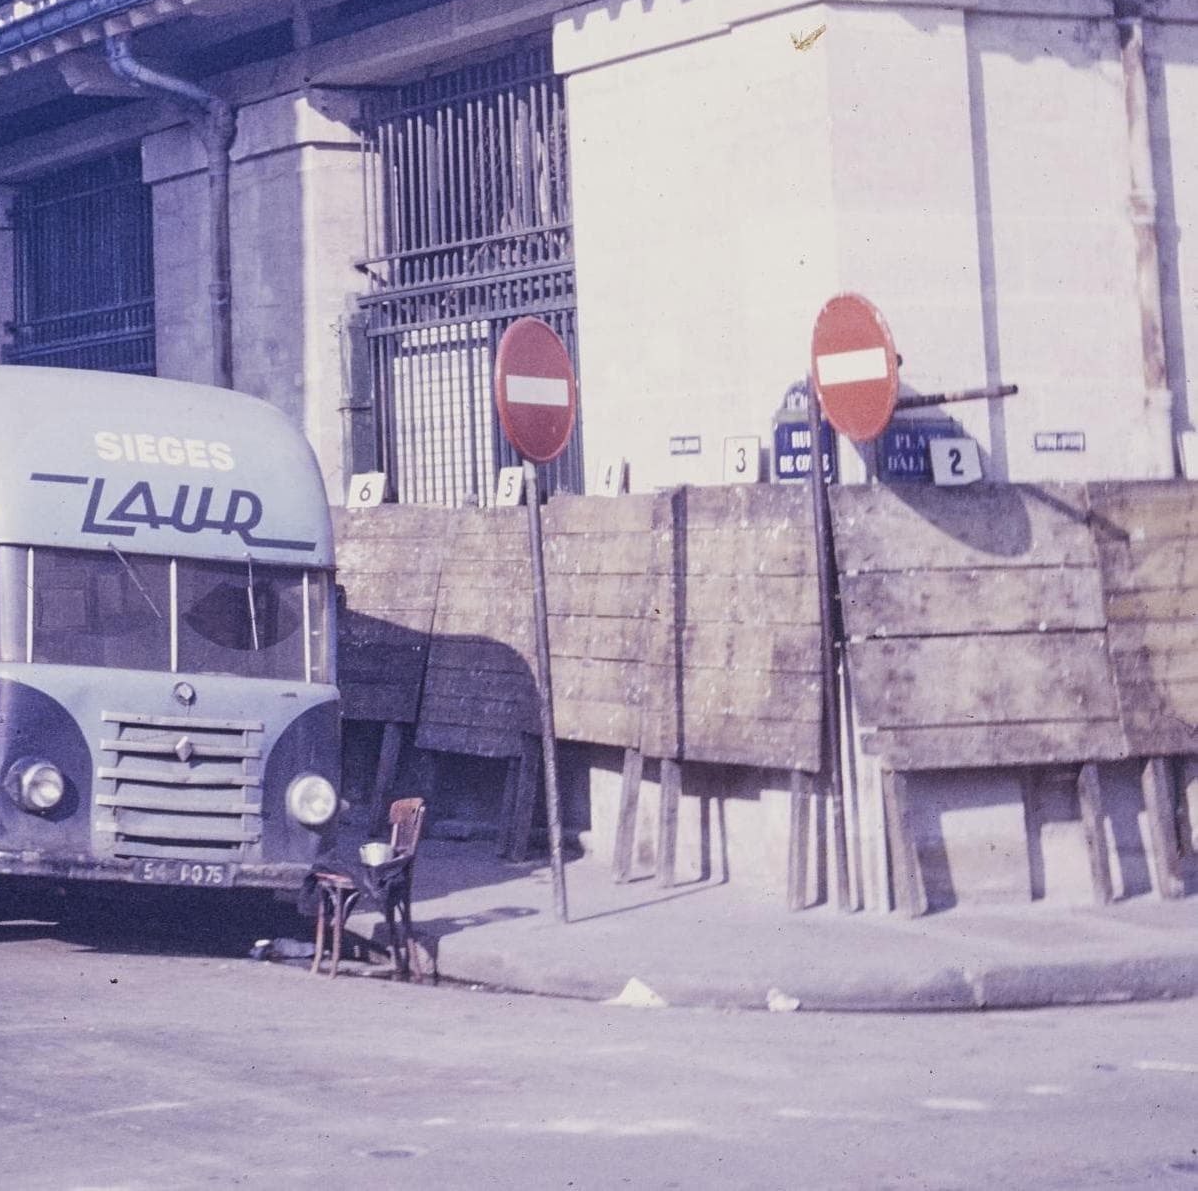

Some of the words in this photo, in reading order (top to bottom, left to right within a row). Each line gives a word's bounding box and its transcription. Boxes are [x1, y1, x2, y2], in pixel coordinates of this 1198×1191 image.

[94, 431, 236, 472] SIEGES
[736, 447, 746, 473] 3
[948, 448, 964, 476] 2
[359, 481, 371, 502] 6
[505, 476, 515, 498] 5
[81, 475, 316, 552] LAUR
